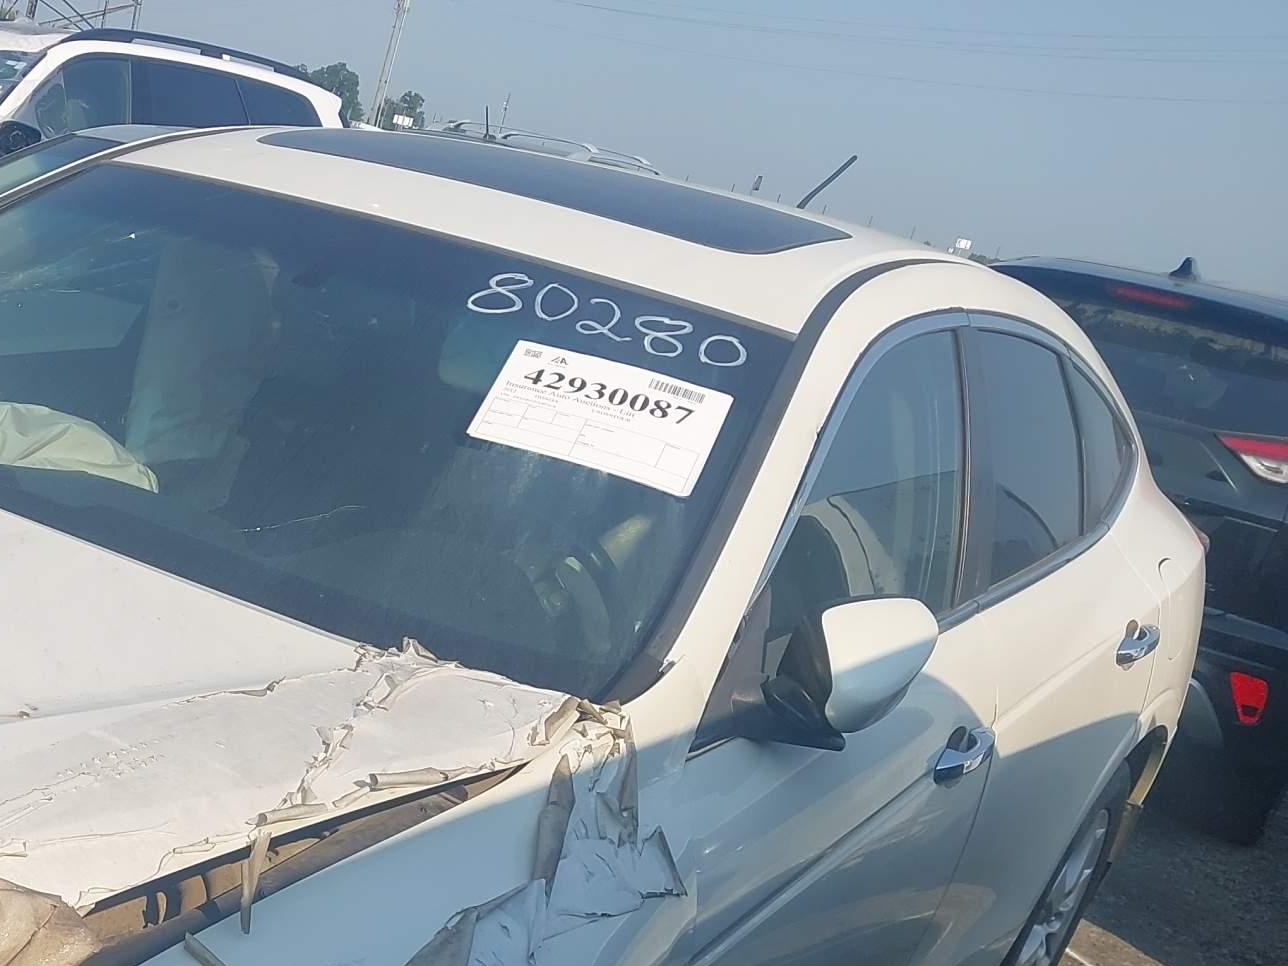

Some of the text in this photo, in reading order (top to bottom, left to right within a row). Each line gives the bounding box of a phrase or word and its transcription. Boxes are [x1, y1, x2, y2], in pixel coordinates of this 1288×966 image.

[465, 272, 748, 368] 80280
[523, 368, 696, 425] 42930087
[548, 387, 571, 400] Auto
